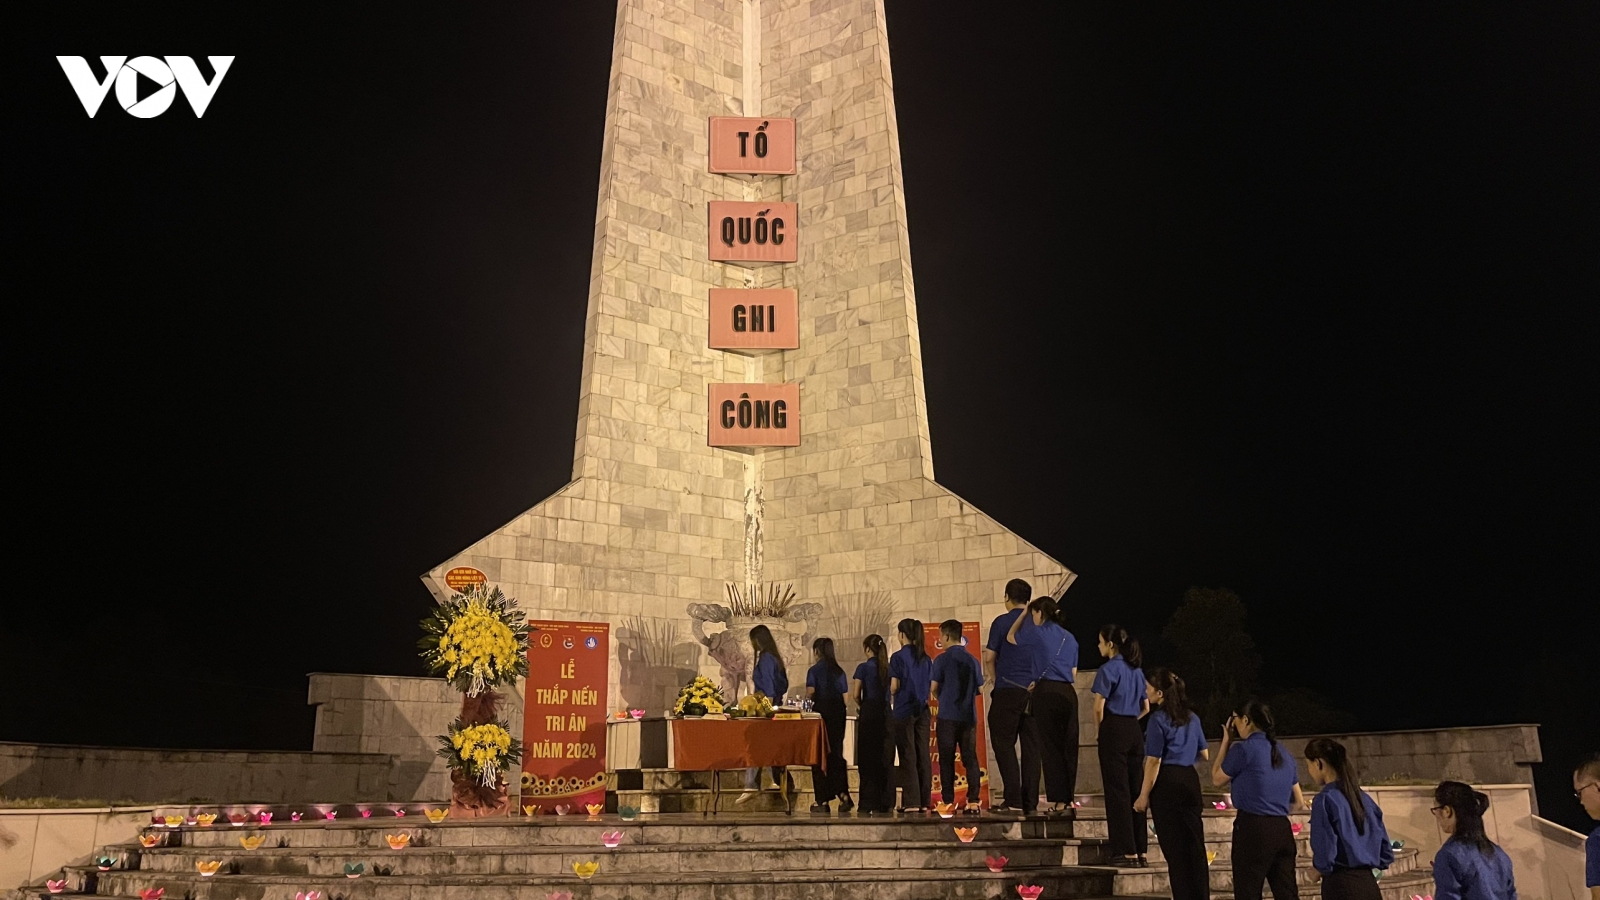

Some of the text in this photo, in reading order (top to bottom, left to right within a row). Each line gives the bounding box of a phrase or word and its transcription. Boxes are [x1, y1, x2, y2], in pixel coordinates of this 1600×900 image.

[736, 120, 769, 158] TỔ
[721, 208, 785, 247] QUỐC
[732, 304, 776, 333] GHI
[720, 392, 787, 429] CÔNG
[560, 658, 576, 679] LỄ
[536, 683, 598, 706] THẮP NẾN
[545, 713, 587, 732] TRI ÂN
[532, 739, 597, 759] NĂM 2024
